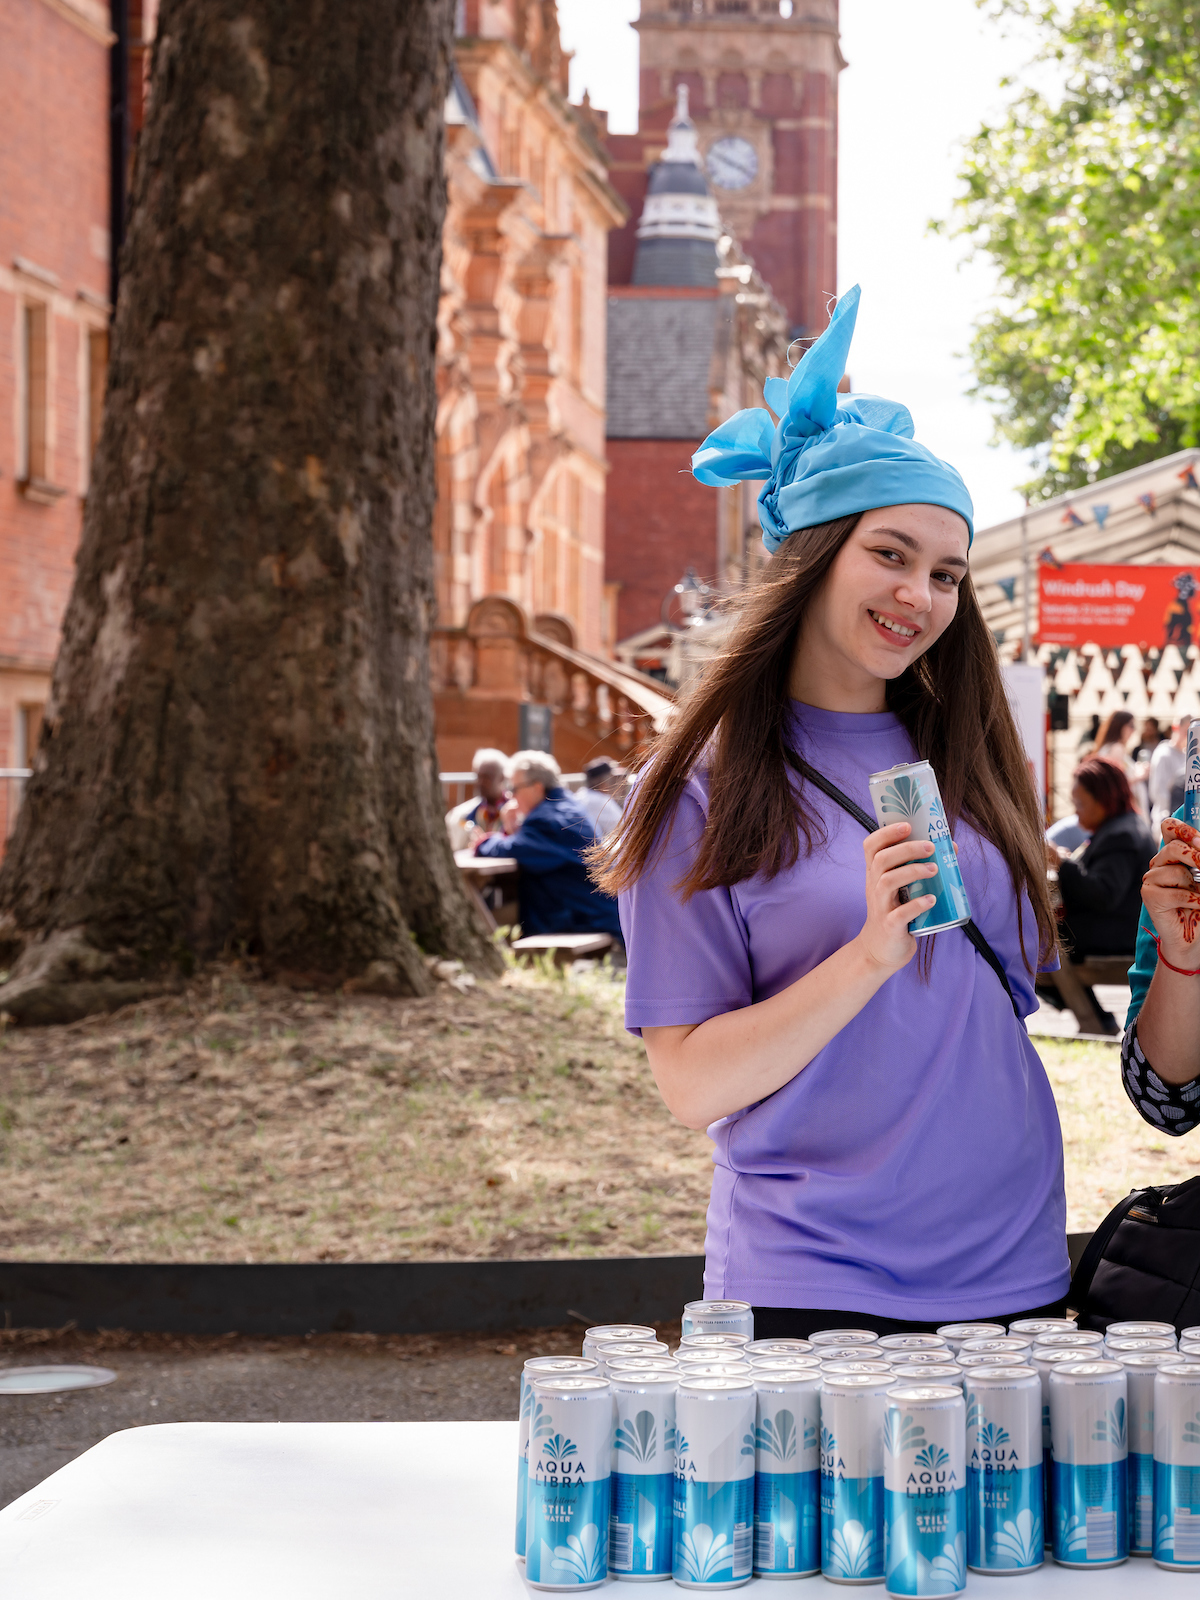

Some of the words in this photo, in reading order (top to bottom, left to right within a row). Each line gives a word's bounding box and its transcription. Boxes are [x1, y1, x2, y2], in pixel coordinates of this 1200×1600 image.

[1042, 579, 1114, 597] Windrush
[1115, 580, 1146, 602] Day
[971, 1448, 1019, 1462] AQUA
[536, 1460, 586, 1474] AQUA
[970, 1462, 1019, 1476] LIBRA
[535, 1474, 586, 1488] LIBRA
[906, 1470, 957, 1485] AQUA
[906, 1485, 957, 1499] LIBRA
[979, 1491, 1010, 1502] STILL
[541, 1505, 574, 1515] STILL
[543, 1515, 571, 1523] WATER
[916, 1515, 950, 1527] STILL
[919, 1526, 947, 1534] WATER
